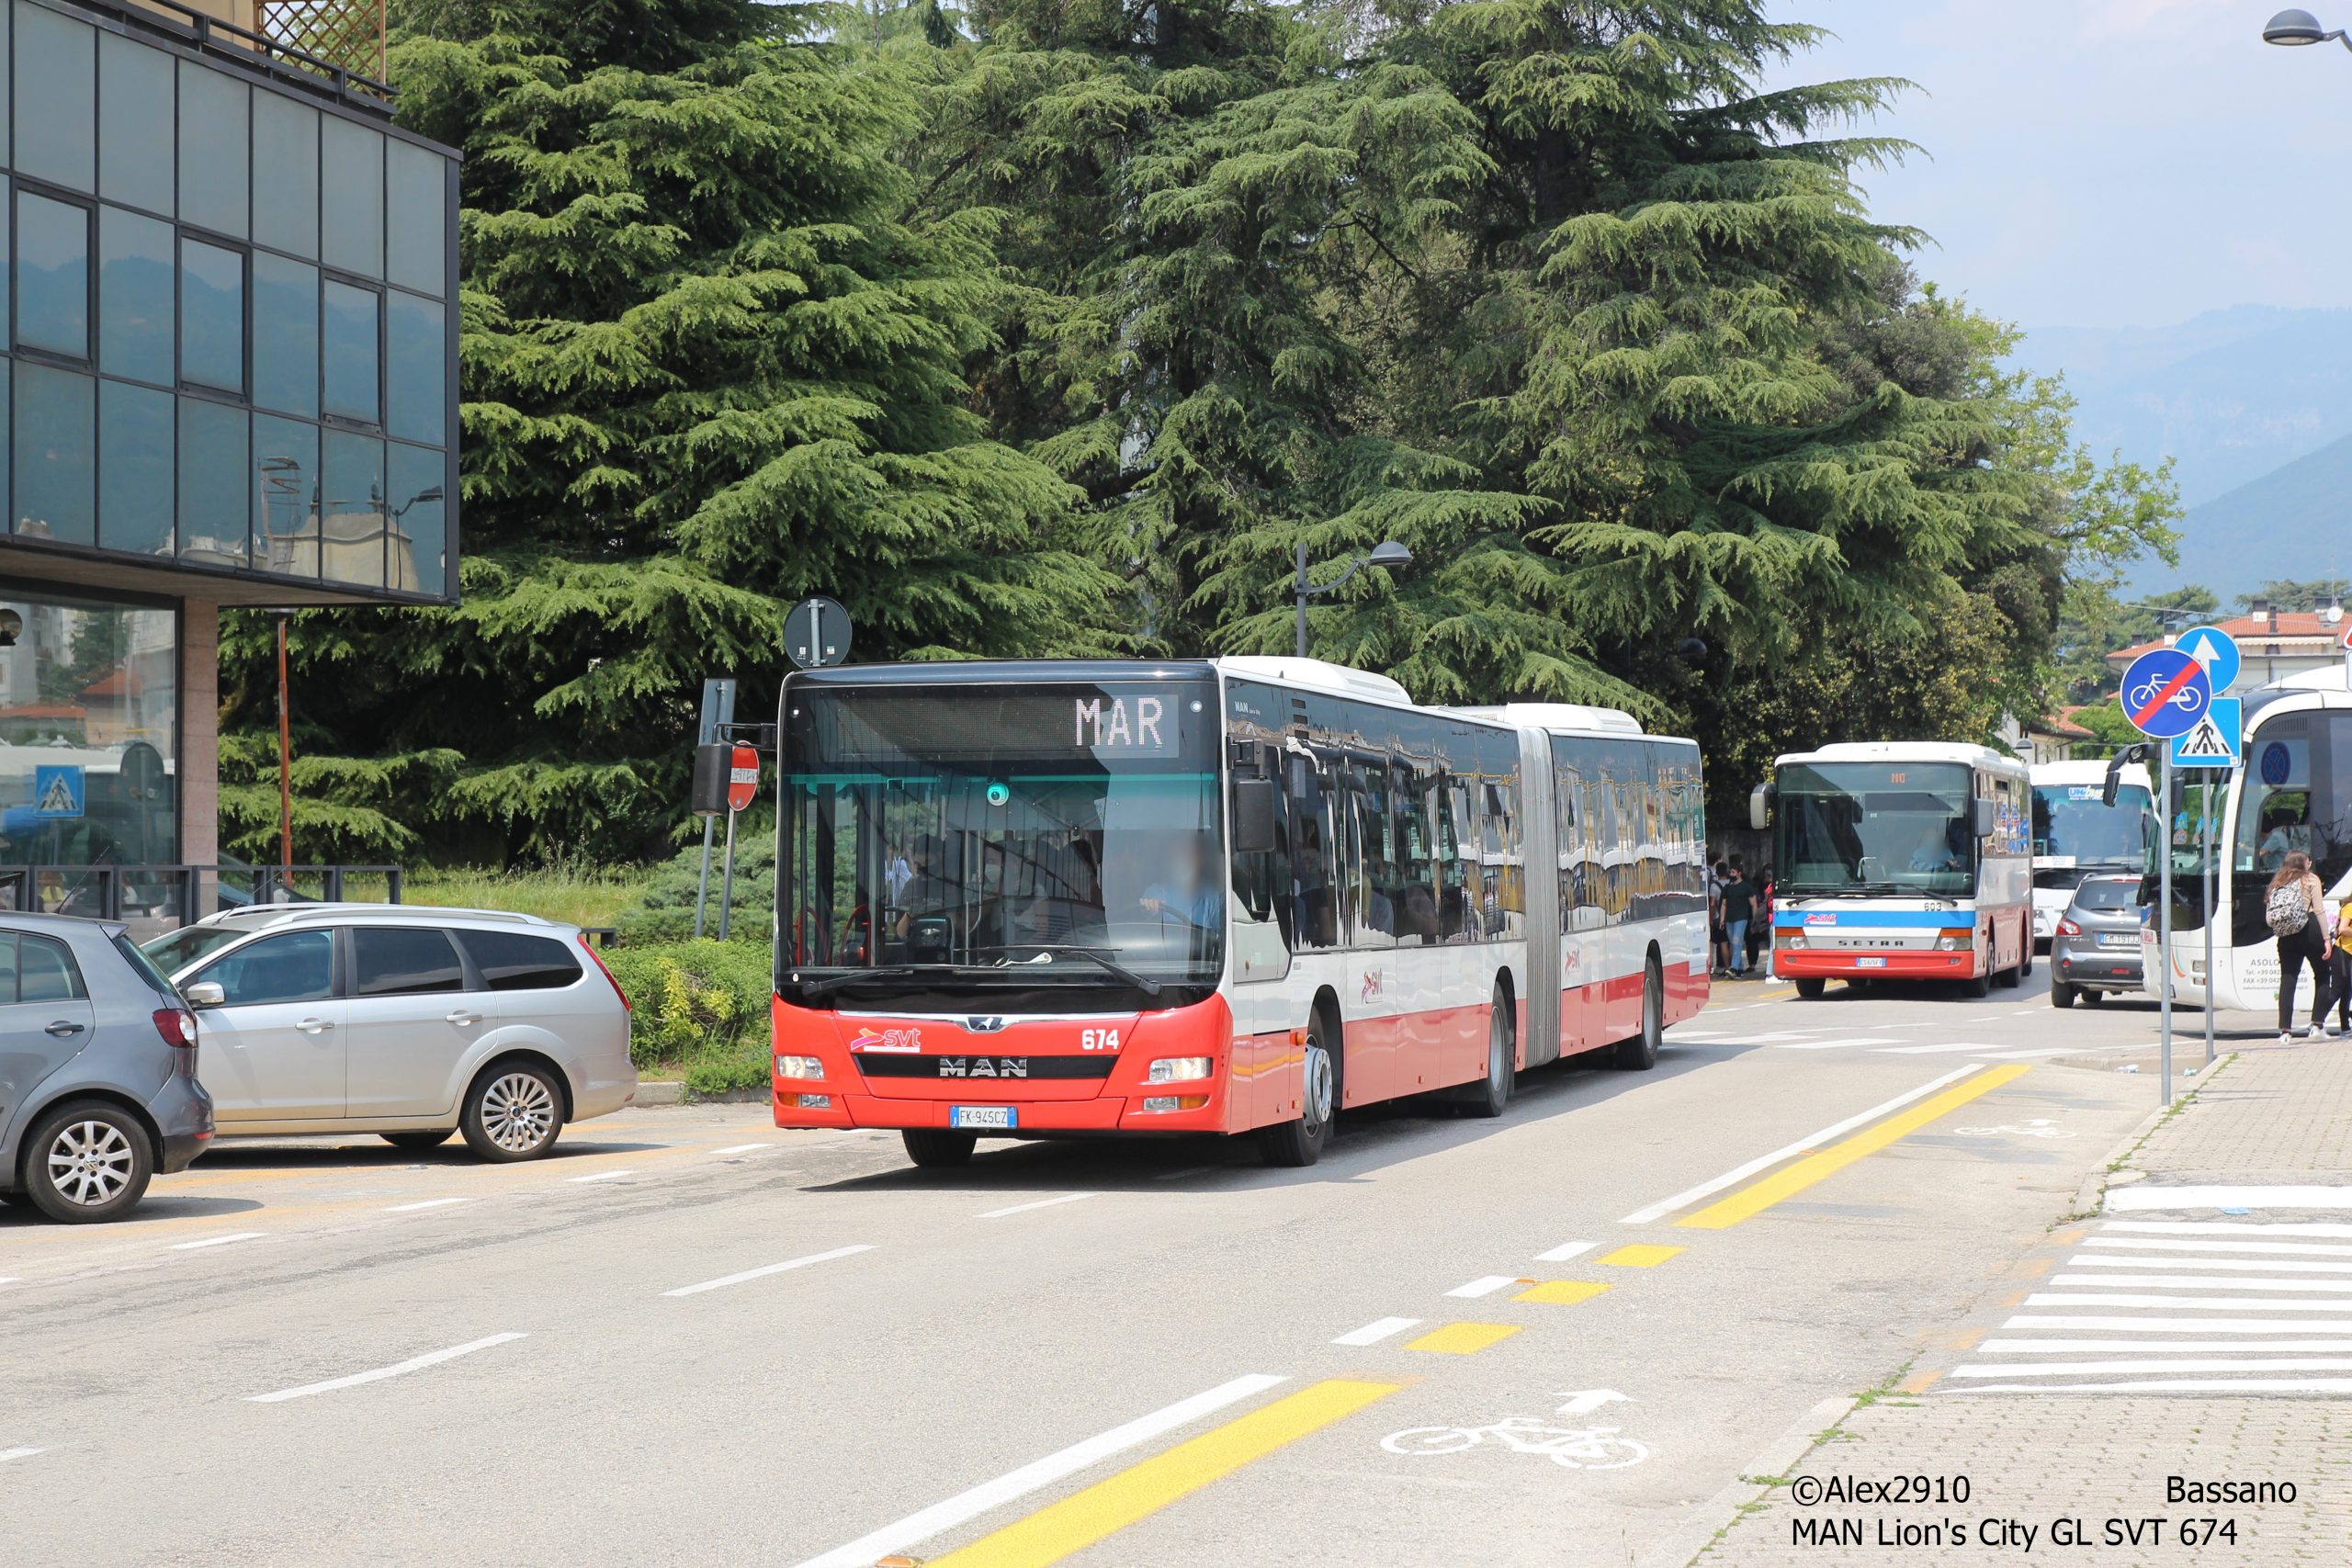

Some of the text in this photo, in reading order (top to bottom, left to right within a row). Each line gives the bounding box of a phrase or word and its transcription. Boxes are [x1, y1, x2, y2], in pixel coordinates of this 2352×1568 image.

[1076, 697, 1162, 746] MAR
[1924, 902, 1942, 912] 603
[884, 1028, 922, 1047] svt
[1081, 1029, 1119, 1049] 674
[939, 1055, 1027, 1077] MAN
